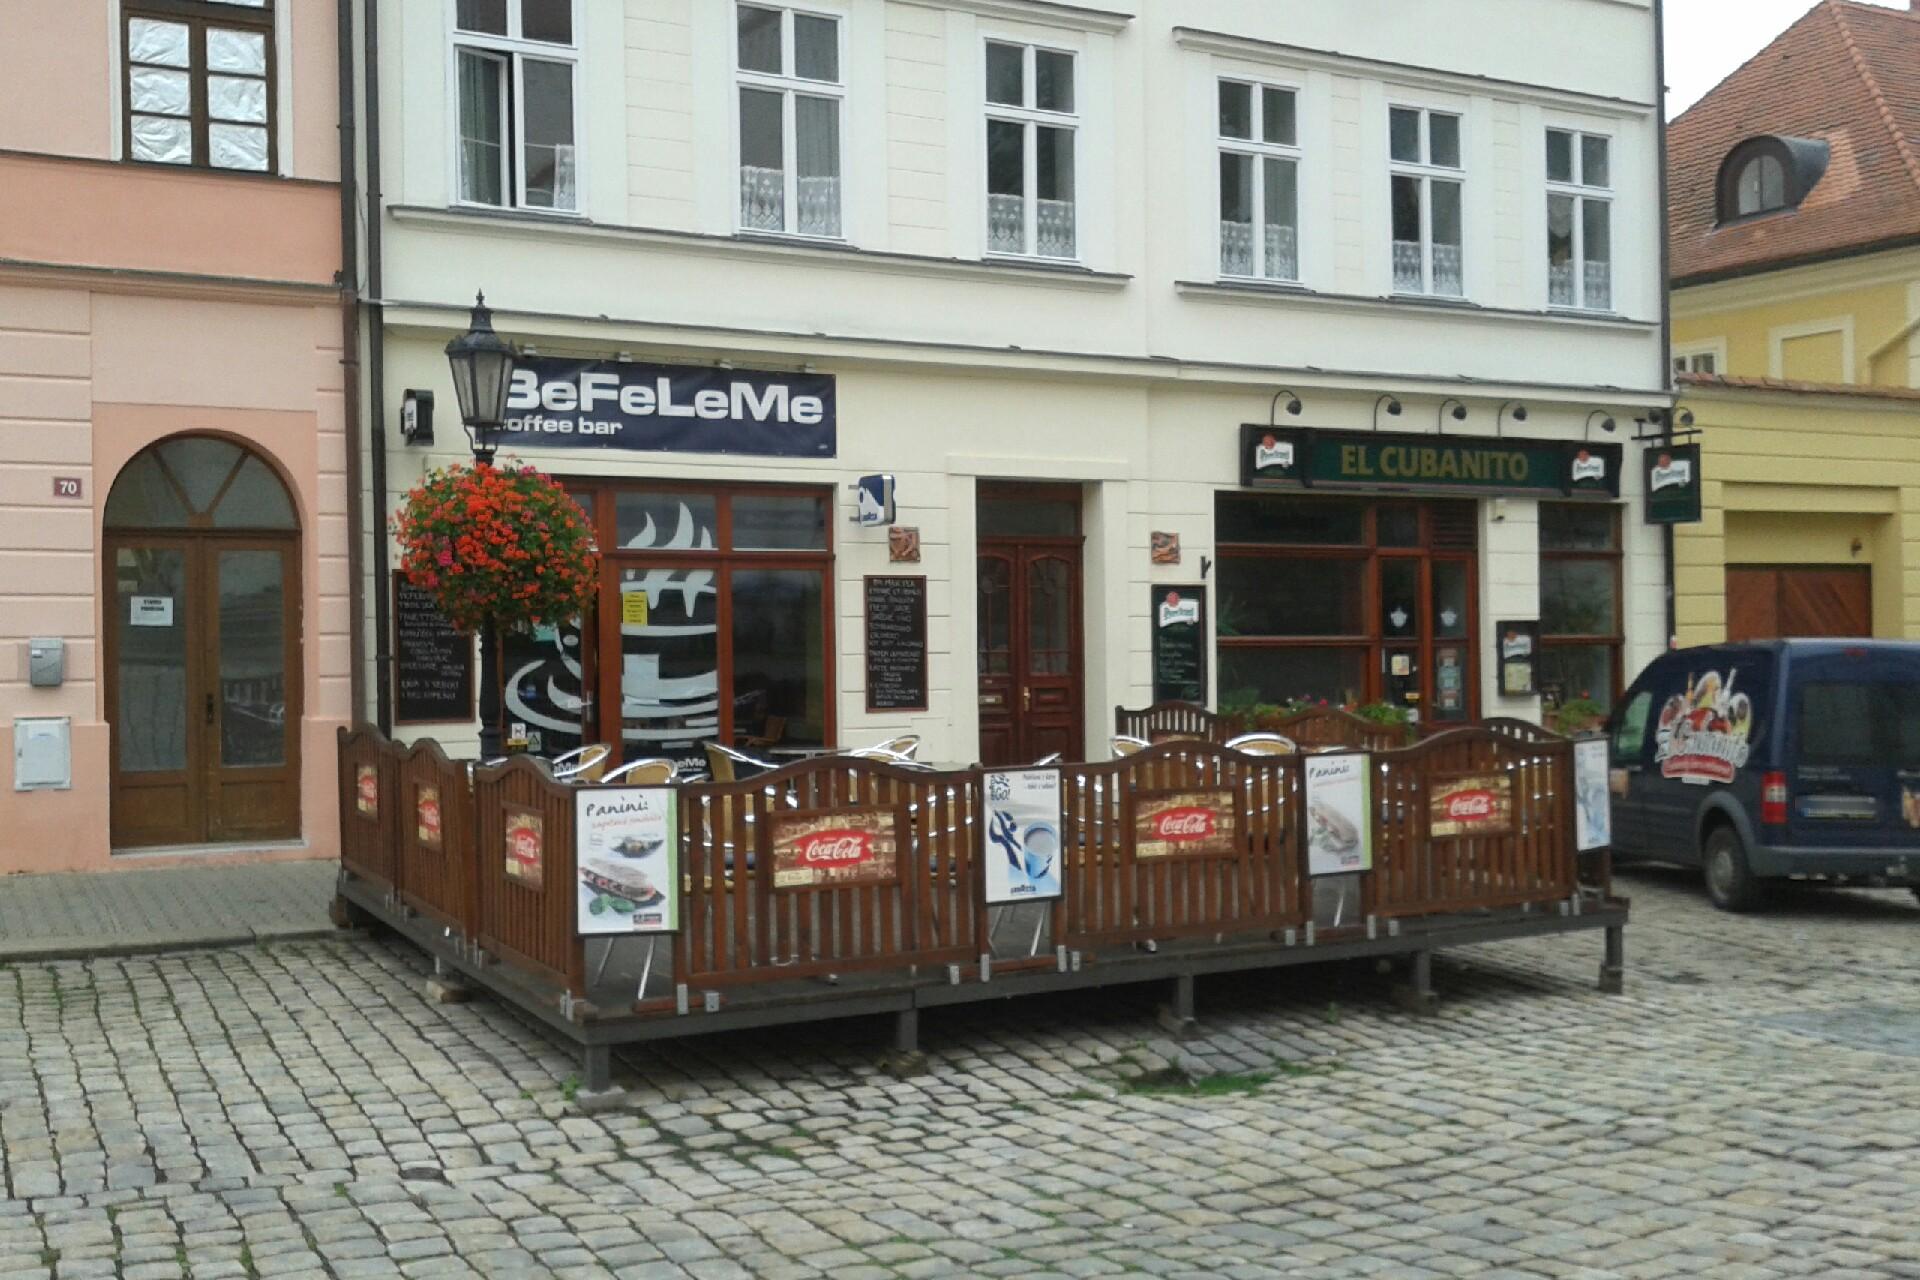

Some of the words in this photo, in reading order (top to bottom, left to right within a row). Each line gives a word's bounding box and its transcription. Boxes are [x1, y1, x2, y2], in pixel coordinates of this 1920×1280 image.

[578, 416, 623, 435] bar
[1341, 445, 1374, 475] EL
[1379, 446, 1529, 480] CUBANITO
[60, 481, 77, 495] 70
